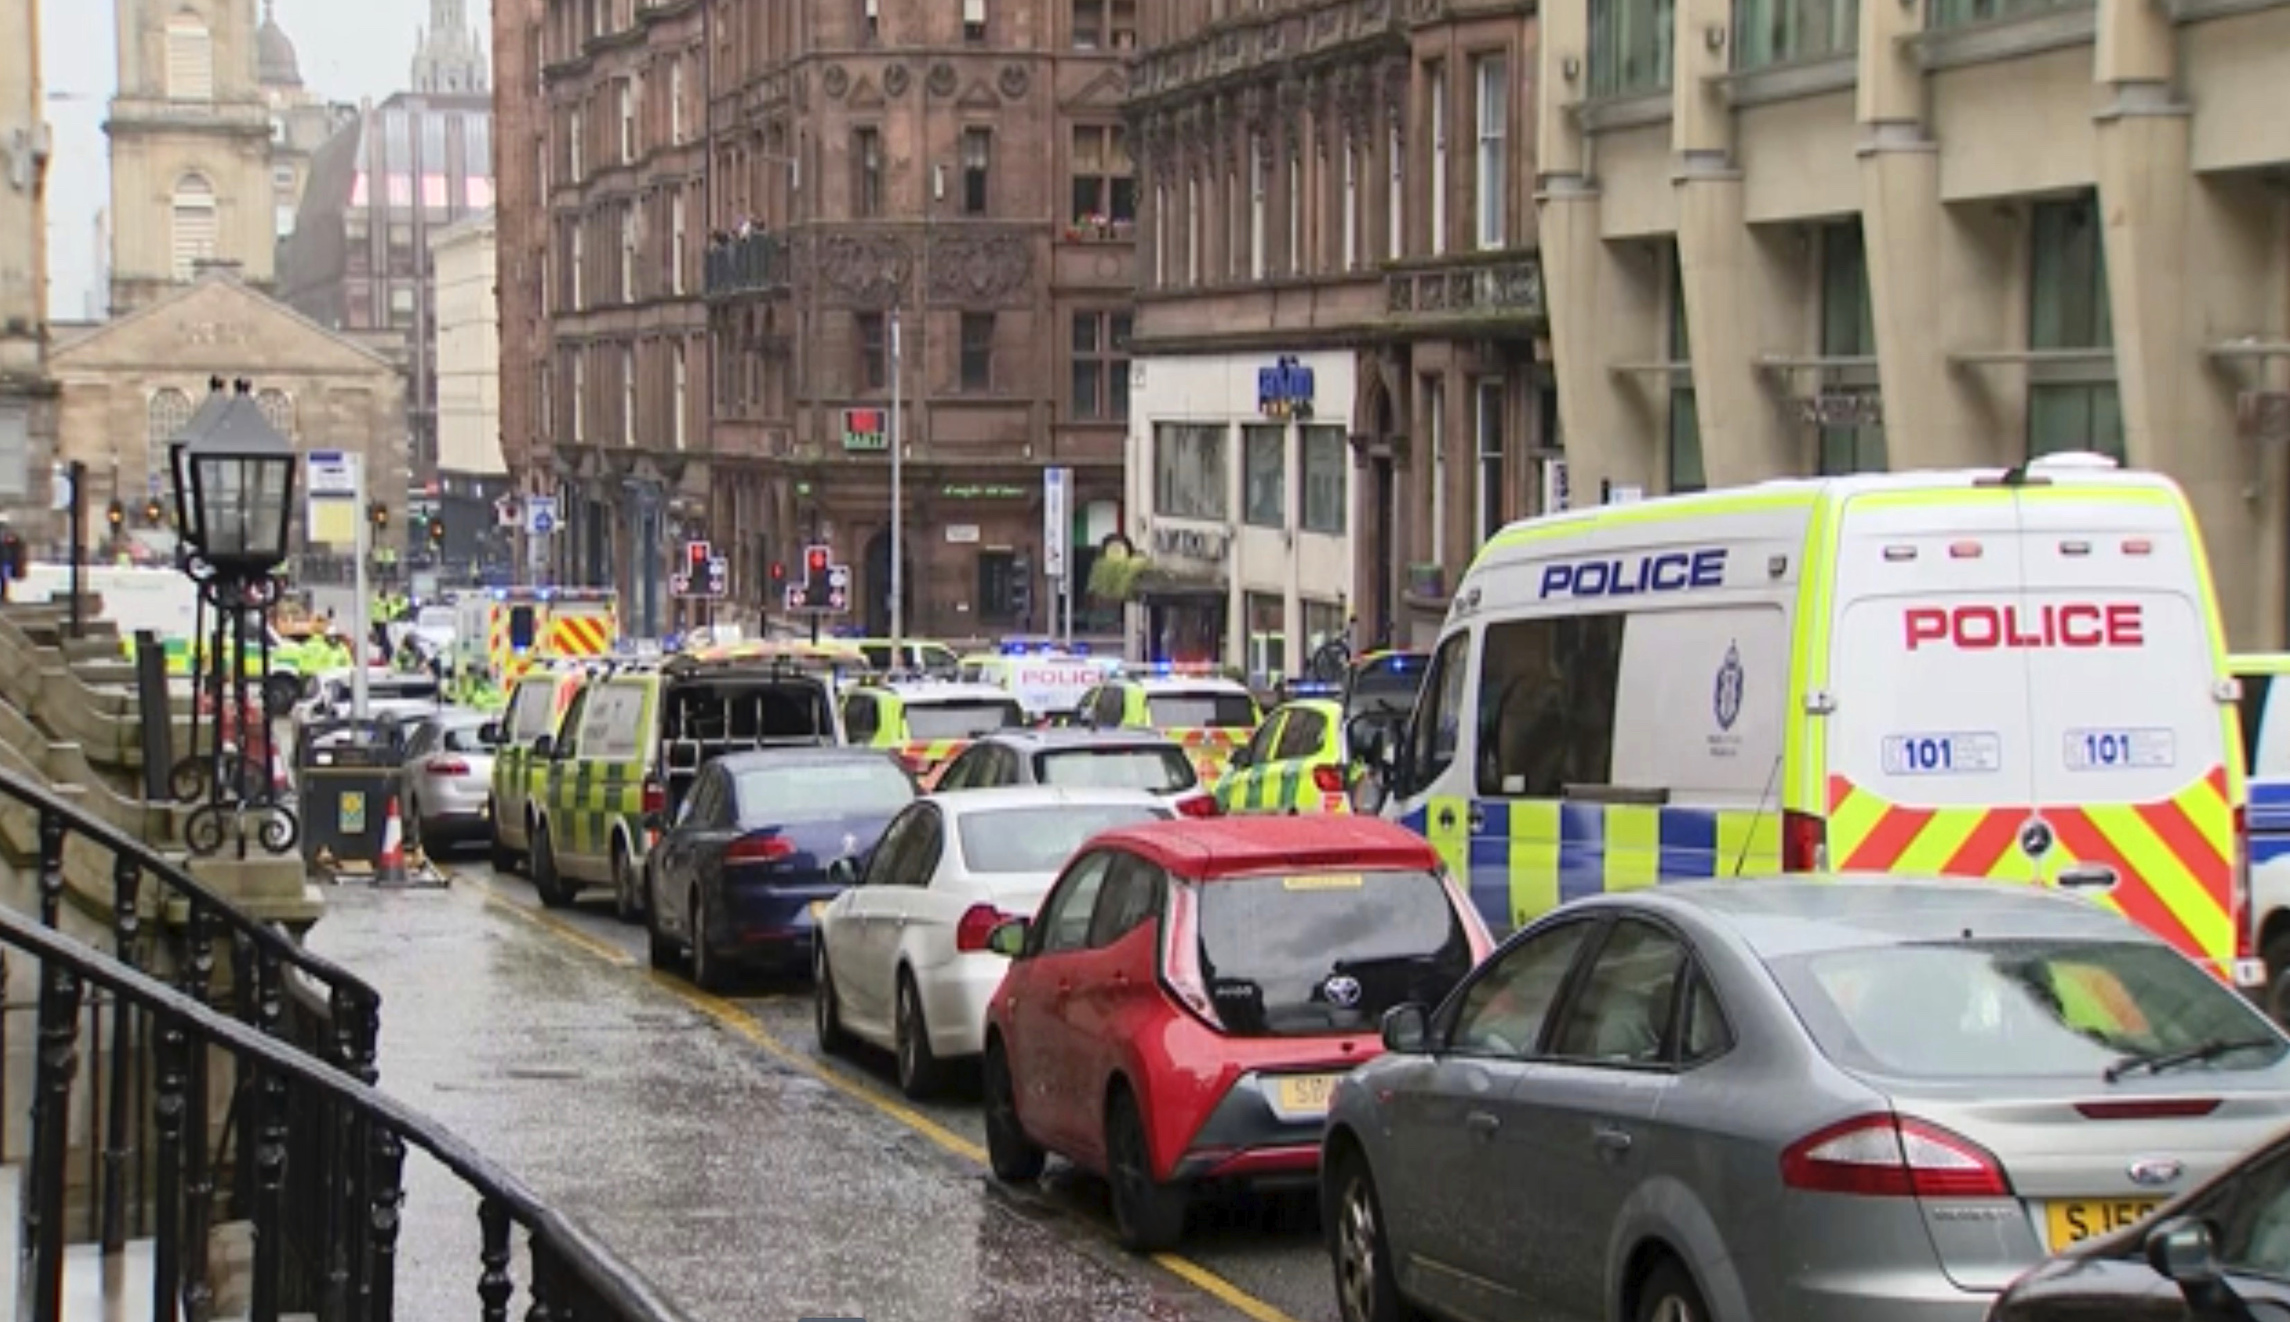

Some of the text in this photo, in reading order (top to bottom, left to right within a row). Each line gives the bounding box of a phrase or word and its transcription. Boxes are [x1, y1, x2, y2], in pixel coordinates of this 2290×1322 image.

[1539, 548, 1728, 599] POLICE
[1904, 604, 2145, 651] POLICE
[1906, 738, 1951, 769] 101
[2086, 733, 2129, 765] 101
